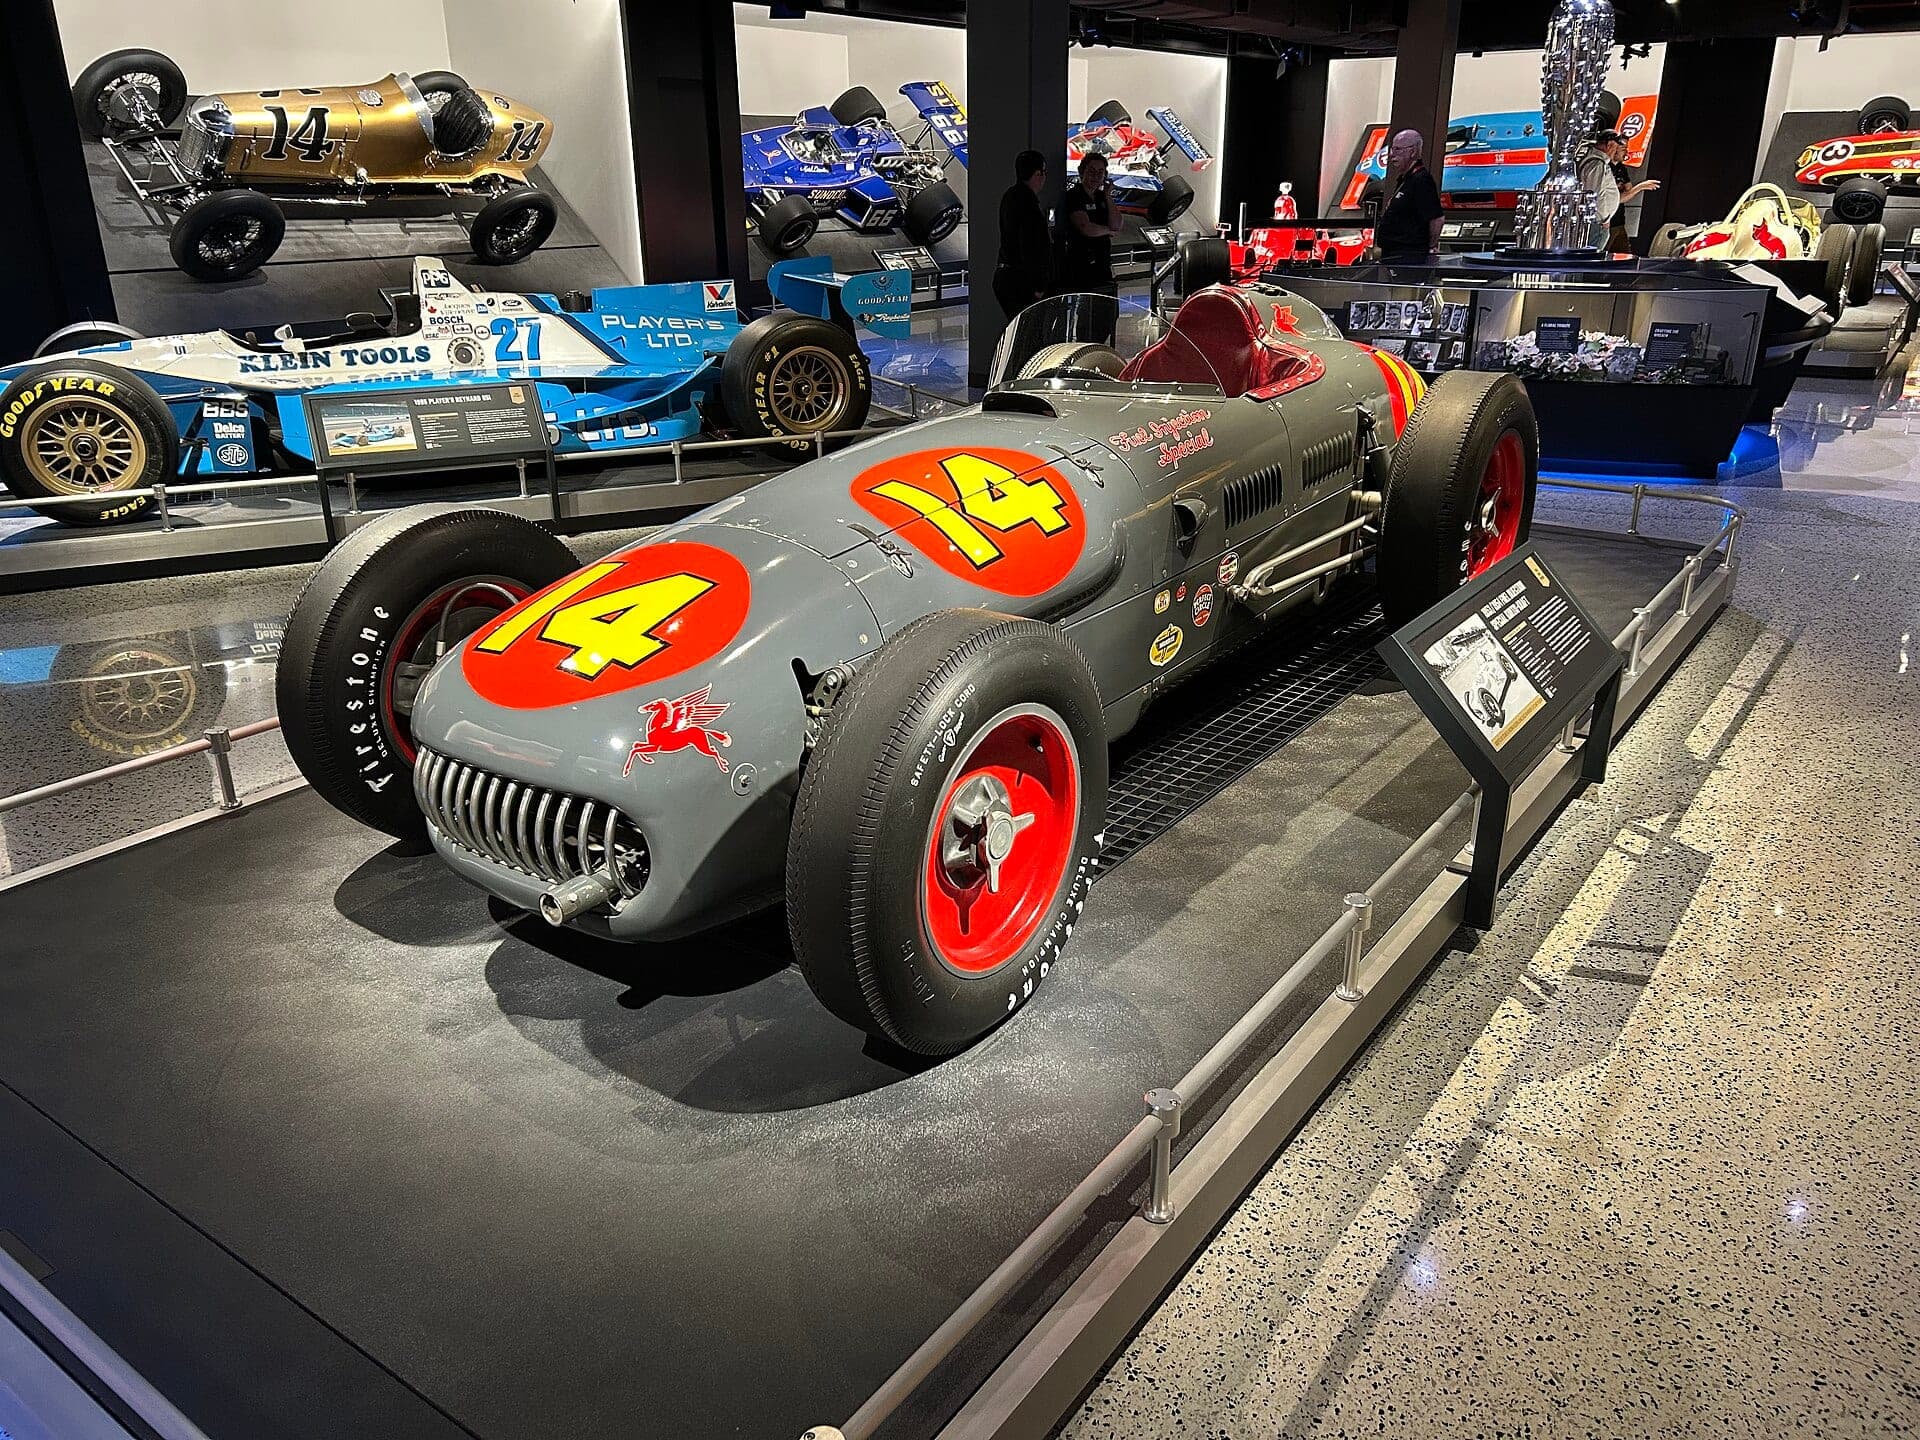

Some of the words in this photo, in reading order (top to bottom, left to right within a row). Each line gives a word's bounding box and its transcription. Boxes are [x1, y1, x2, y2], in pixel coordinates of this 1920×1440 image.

[261, 105, 334, 161] 14
[495, 120, 545, 161] 14
[930, 114, 964, 146] 66
[1623, 116, 1642, 136] STP
[866, 210, 897, 226] 66
[422, 270, 449, 287] PPG
[429, 316, 464, 324] BOSCH
[490, 317, 541, 361] 27
[601, 315, 725, 330] PLAYER'S
[238, 350, 331, 373] KLEIN
[341, 346, 431, 366] TOOLS
[646, 334, 699, 348] LTD.
[849, 353, 866, 391] EAGLE
[0, 378, 115, 438] GOODYEAR
[203, 402, 249, 417] BBS
[213, 422, 245, 433] Delco
[1109, 427, 1153, 452] Fuel
[1148, 409, 1211, 441] Injection
[1158, 427, 1214, 469] Special
[100, 495, 147, 520] EAGLE
[865, 452, 1073, 571] 14
[472, 560, 719, 682] 14
[368, 640, 386, 706] CHAMPION
[345, 605, 390, 793] Firestone
[369, 712, 388, 758] DELUXE
[910, 707, 956, 787] SAFETY-LOCK
[954, 683, 976, 709] CORD
[1065, 856, 1089, 907] DELUXE
[1021, 911, 1068, 977] CHAMPION
